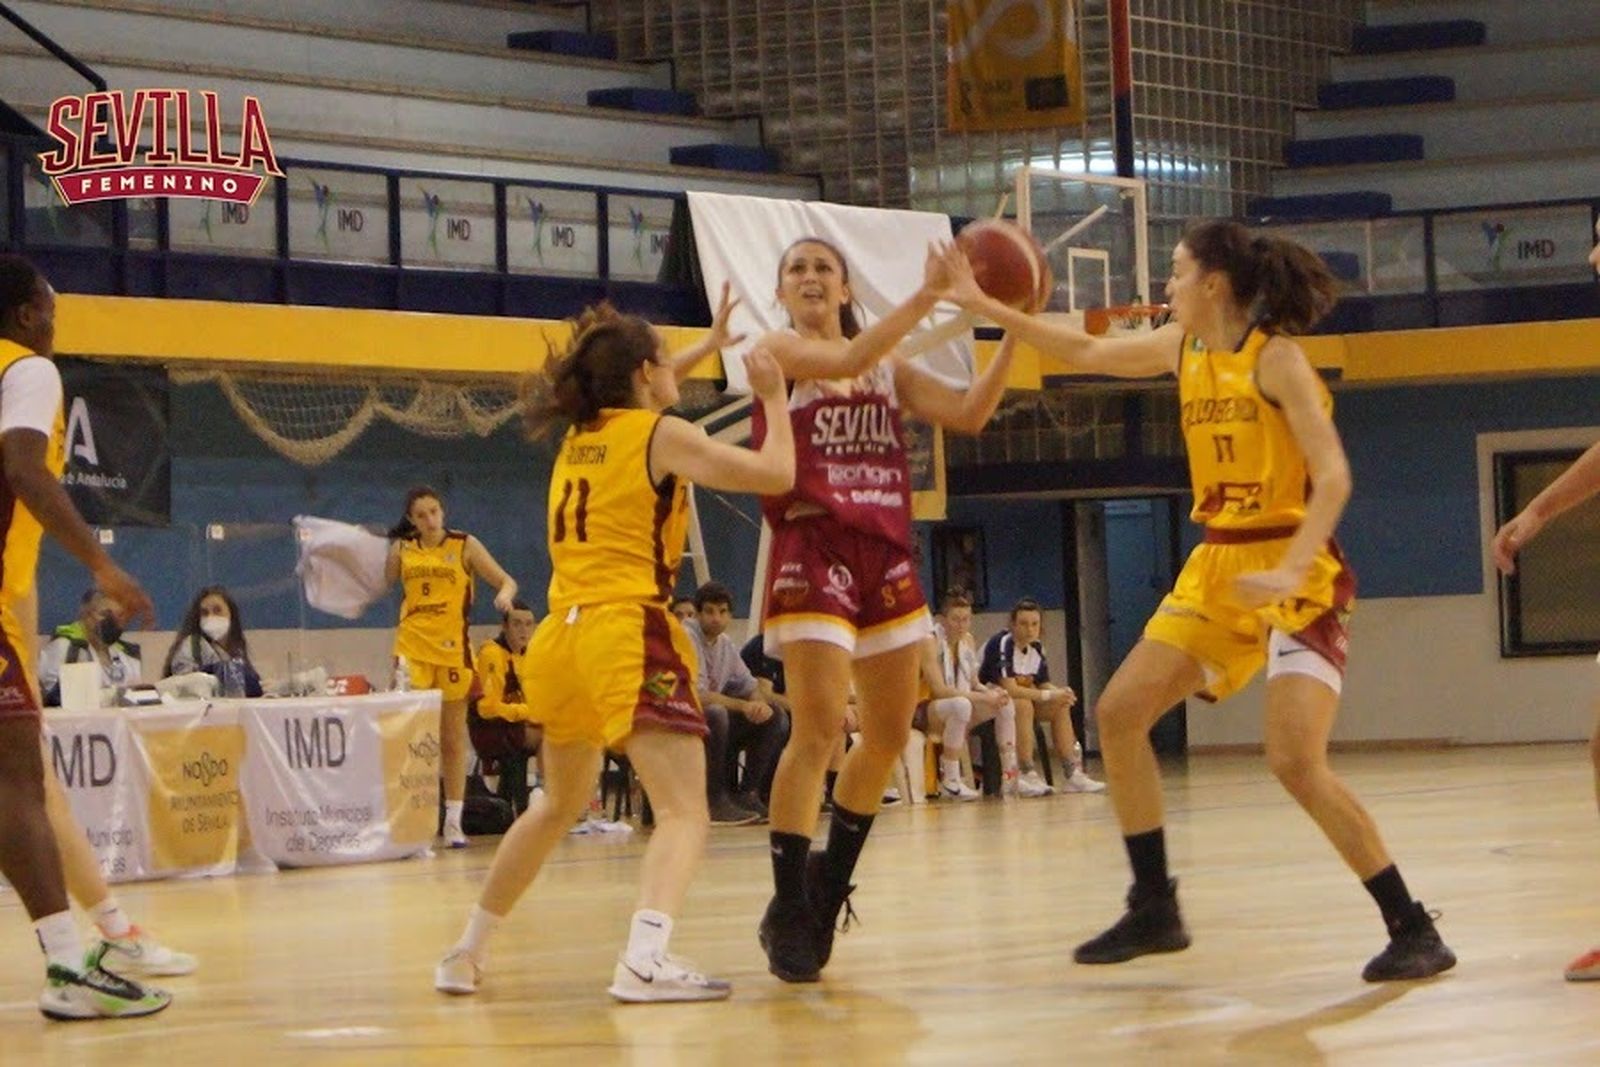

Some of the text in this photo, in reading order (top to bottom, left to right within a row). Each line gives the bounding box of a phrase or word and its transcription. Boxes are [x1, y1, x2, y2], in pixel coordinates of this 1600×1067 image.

[221, 203, 249, 225] IMD
[337, 209, 363, 233] IMD
[446, 218, 471, 241] IMD
[552, 226, 575, 248] IMD
[1517, 239, 1556, 260] IMD
[554, 477, 590, 543] 11
[448, 667, 459, 683] 6
[284, 717, 346, 769] IMD
[50, 734, 116, 788] MD
